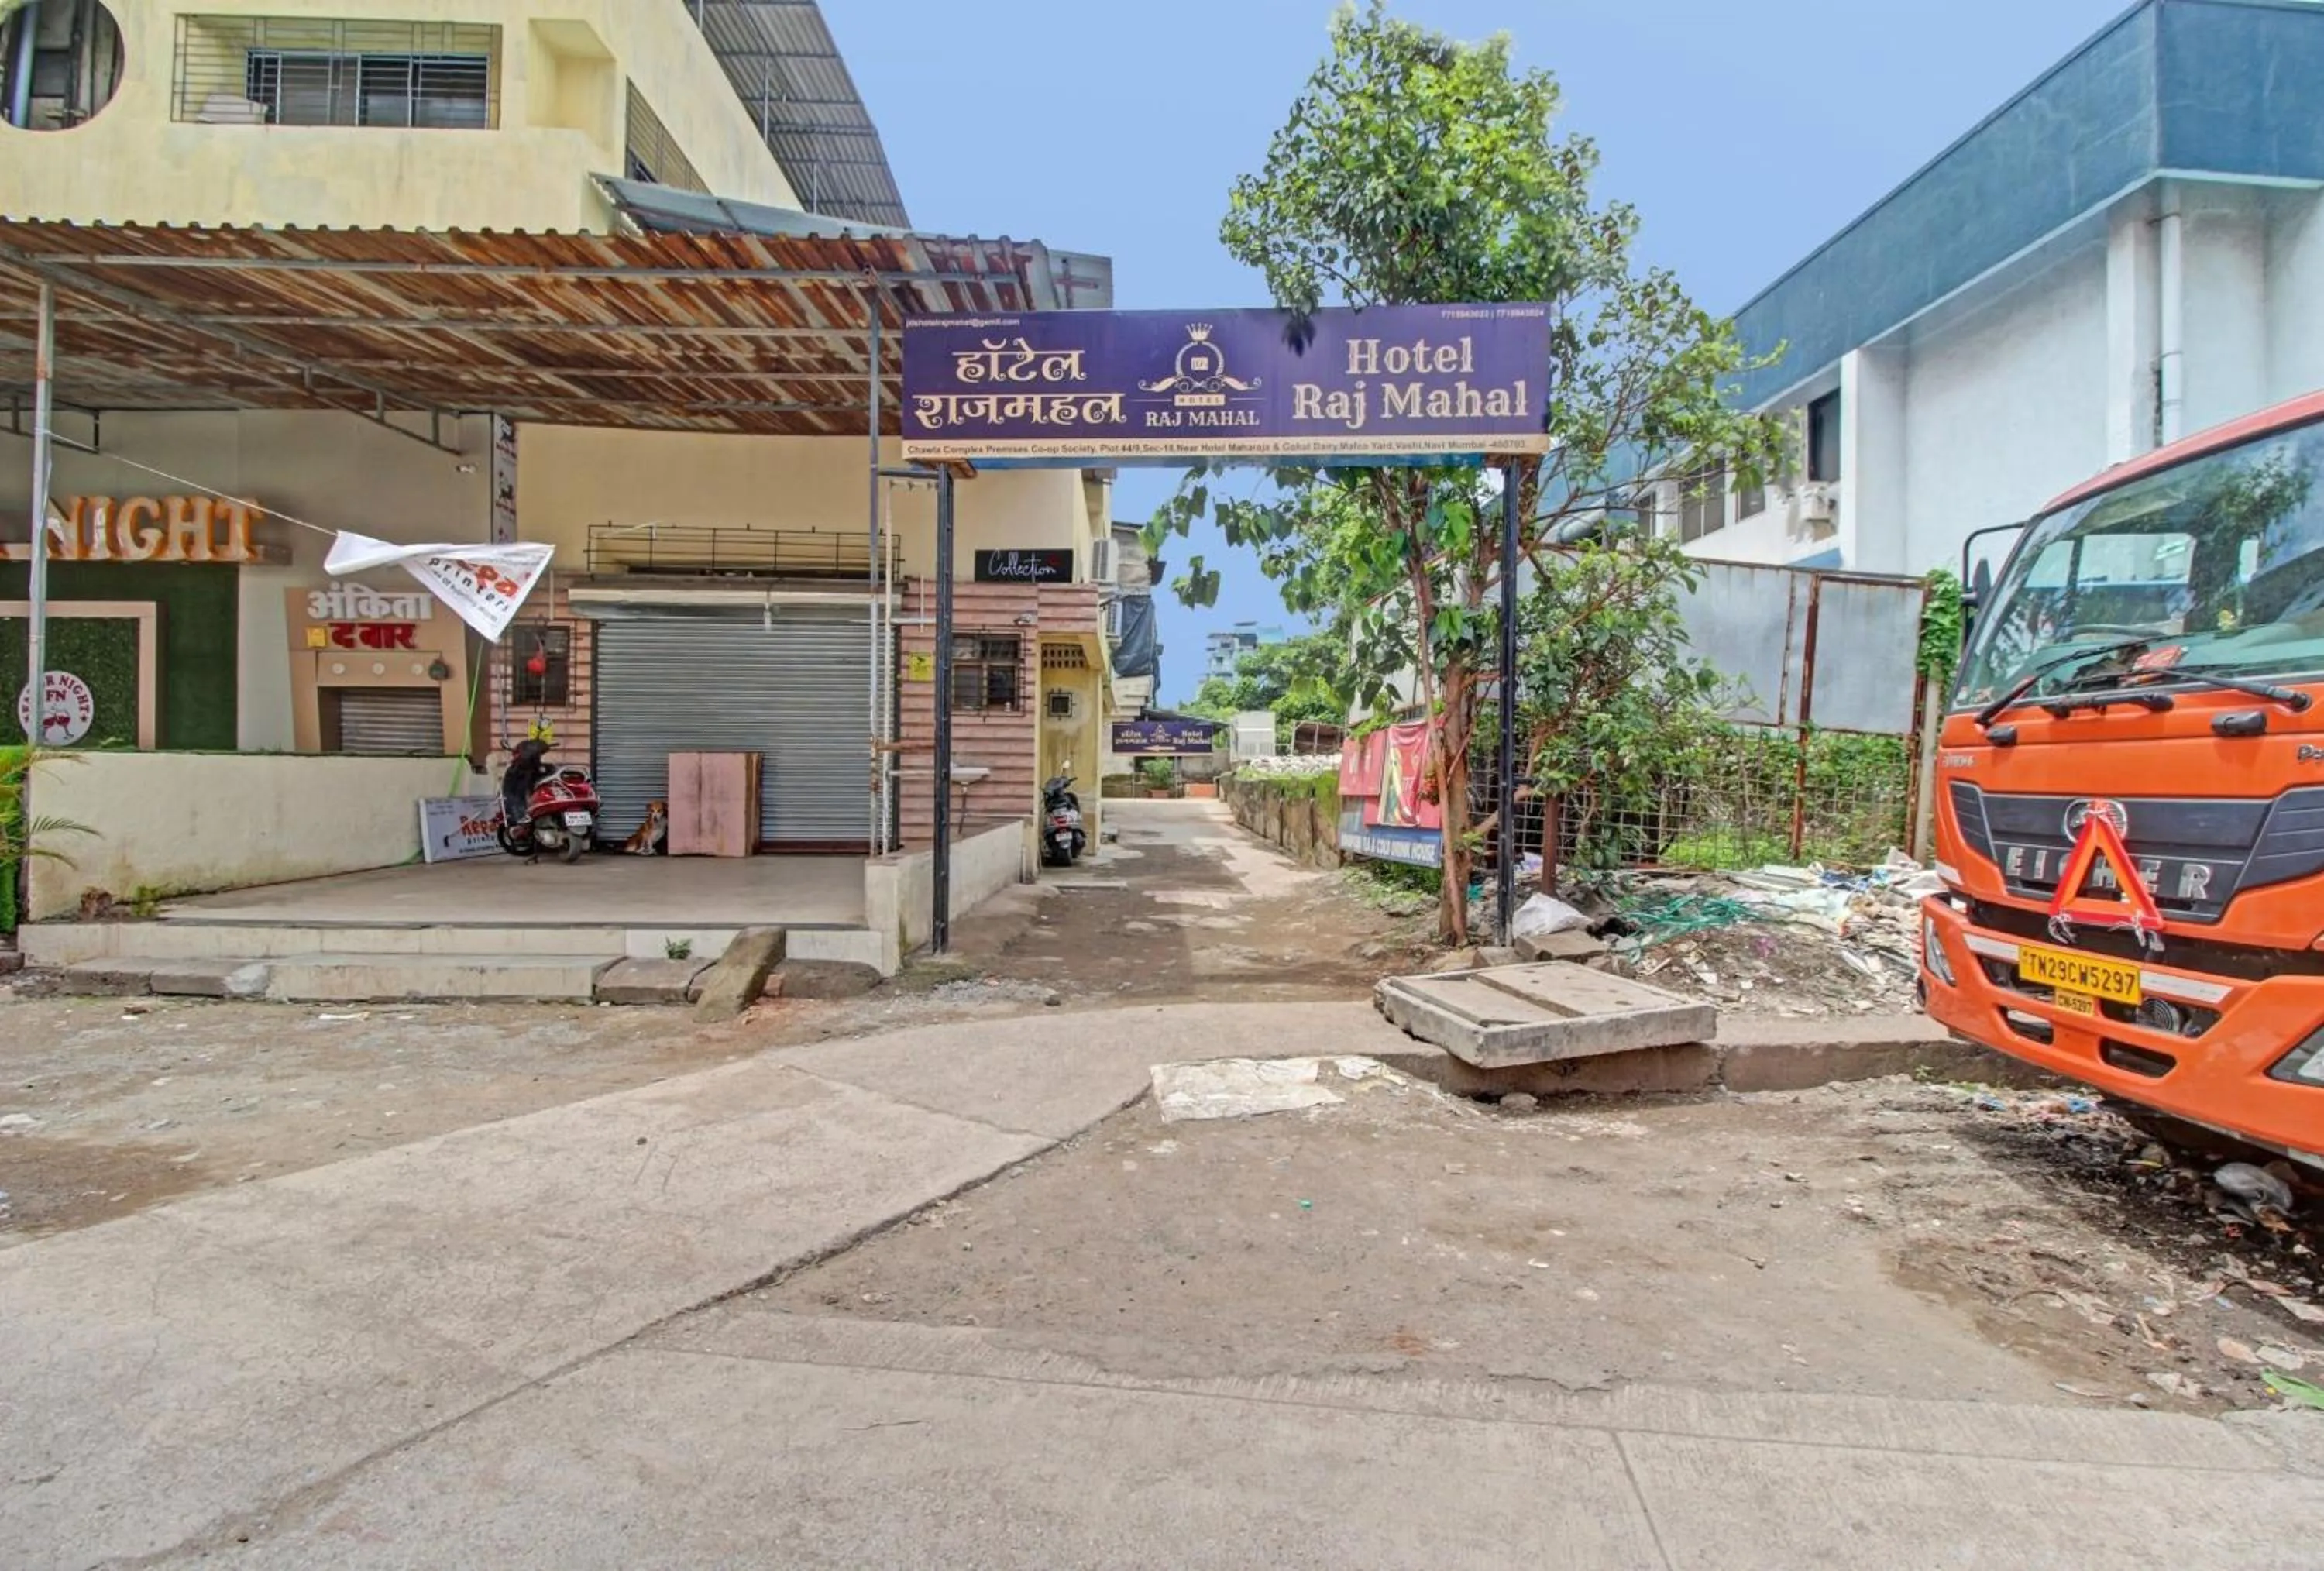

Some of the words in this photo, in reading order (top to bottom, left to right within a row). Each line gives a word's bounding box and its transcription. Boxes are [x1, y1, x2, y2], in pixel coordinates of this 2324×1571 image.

[951, 337, 1088, 383] हॉटेल
[1346, 335, 1474, 374] Hotel
[912, 393, 1127, 428] राजमहल
[1146, 411, 1183, 427] RAJ
[1188, 410, 1260, 426] MAHAL
[1292, 380, 1367, 428] Raj
[1380, 380, 1528, 418] Mahal
[943, 445, 983, 455] Complex
[986, 445, 1028, 454] Premises
[1031, 445, 1059, 455] Co-op
[1201, 443, 1226, 452] Hotel
[1273, 443, 1279, 452] &
[1448, 441, 1486, 450] Mumbai
[988, 548, 1057, 583] Collection
[307, 581, 434, 620] अंकिता
[45, 689, 67, 703] FN
[59, 675, 91, 713] NIGHT
[2005, 847, 2211, 899] EIHER
